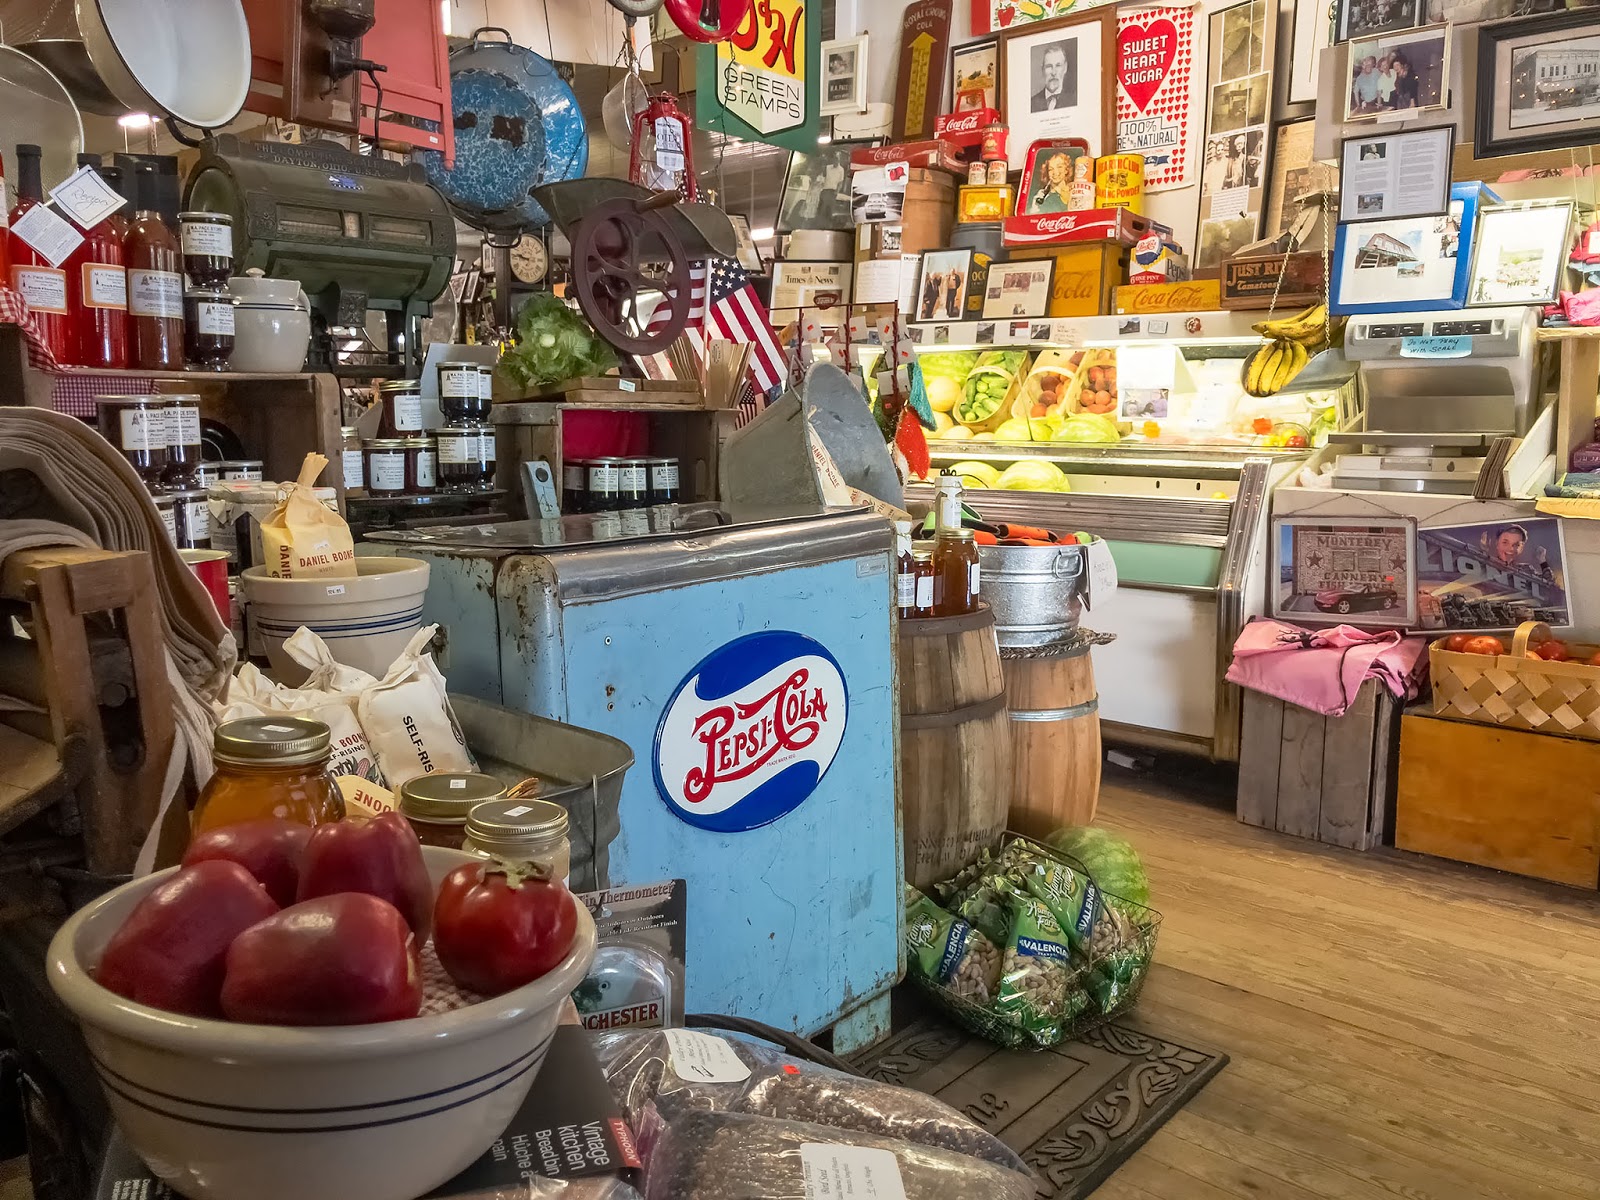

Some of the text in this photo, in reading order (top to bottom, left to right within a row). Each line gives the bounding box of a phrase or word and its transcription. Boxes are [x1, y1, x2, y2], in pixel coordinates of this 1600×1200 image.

[1123, 34, 1168, 56] SWEET
[1123, 51, 1167, 71] HEART
[724, 67, 800, 101] GREEN
[1124, 67, 1163, 86] SUGAR
[724, 85, 801, 119] STAMPS
[946, 115, 979, 132] Coca-Cola
[1125, 120, 1157, 136] 100%
[1137, 130, 1175, 147] NATURAL
[873, 146, 905, 162] Coca-Cola
[1036, 215, 1078, 232] Coca-Cola
[815, 275, 834, 285] News
[1227, 262, 1262, 287] JUST
[1132, 285, 1206, 311] Coca-Cola
[811, 444, 827, 467] DANIEL
[1316, 535, 1393, 552] MONTEREY
[279, 545, 293, 579] DANIE
[299, 549, 354, 568] DANIEL BOONE
[1417, 539, 1545, 601] LIONEL
[1318, 580, 1345, 589] FISH
[1324, 571, 1387, 583] CANNERY
[402, 715, 434, 774] SELF-RIS
[353, 788, 393, 814] OONE
[598, 882, 674, 905] Thermometer
[941, 922, 965, 973] VALENCIA
[1022, 939, 1069, 959] VALENCIA
[582, 1002, 660, 1031] NCHESTER
[557, 1124, 586, 1171] kitchen
[581, 1120, 610, 1166] Vintage
[613, 1120, 636, 1161] TYPHOON
